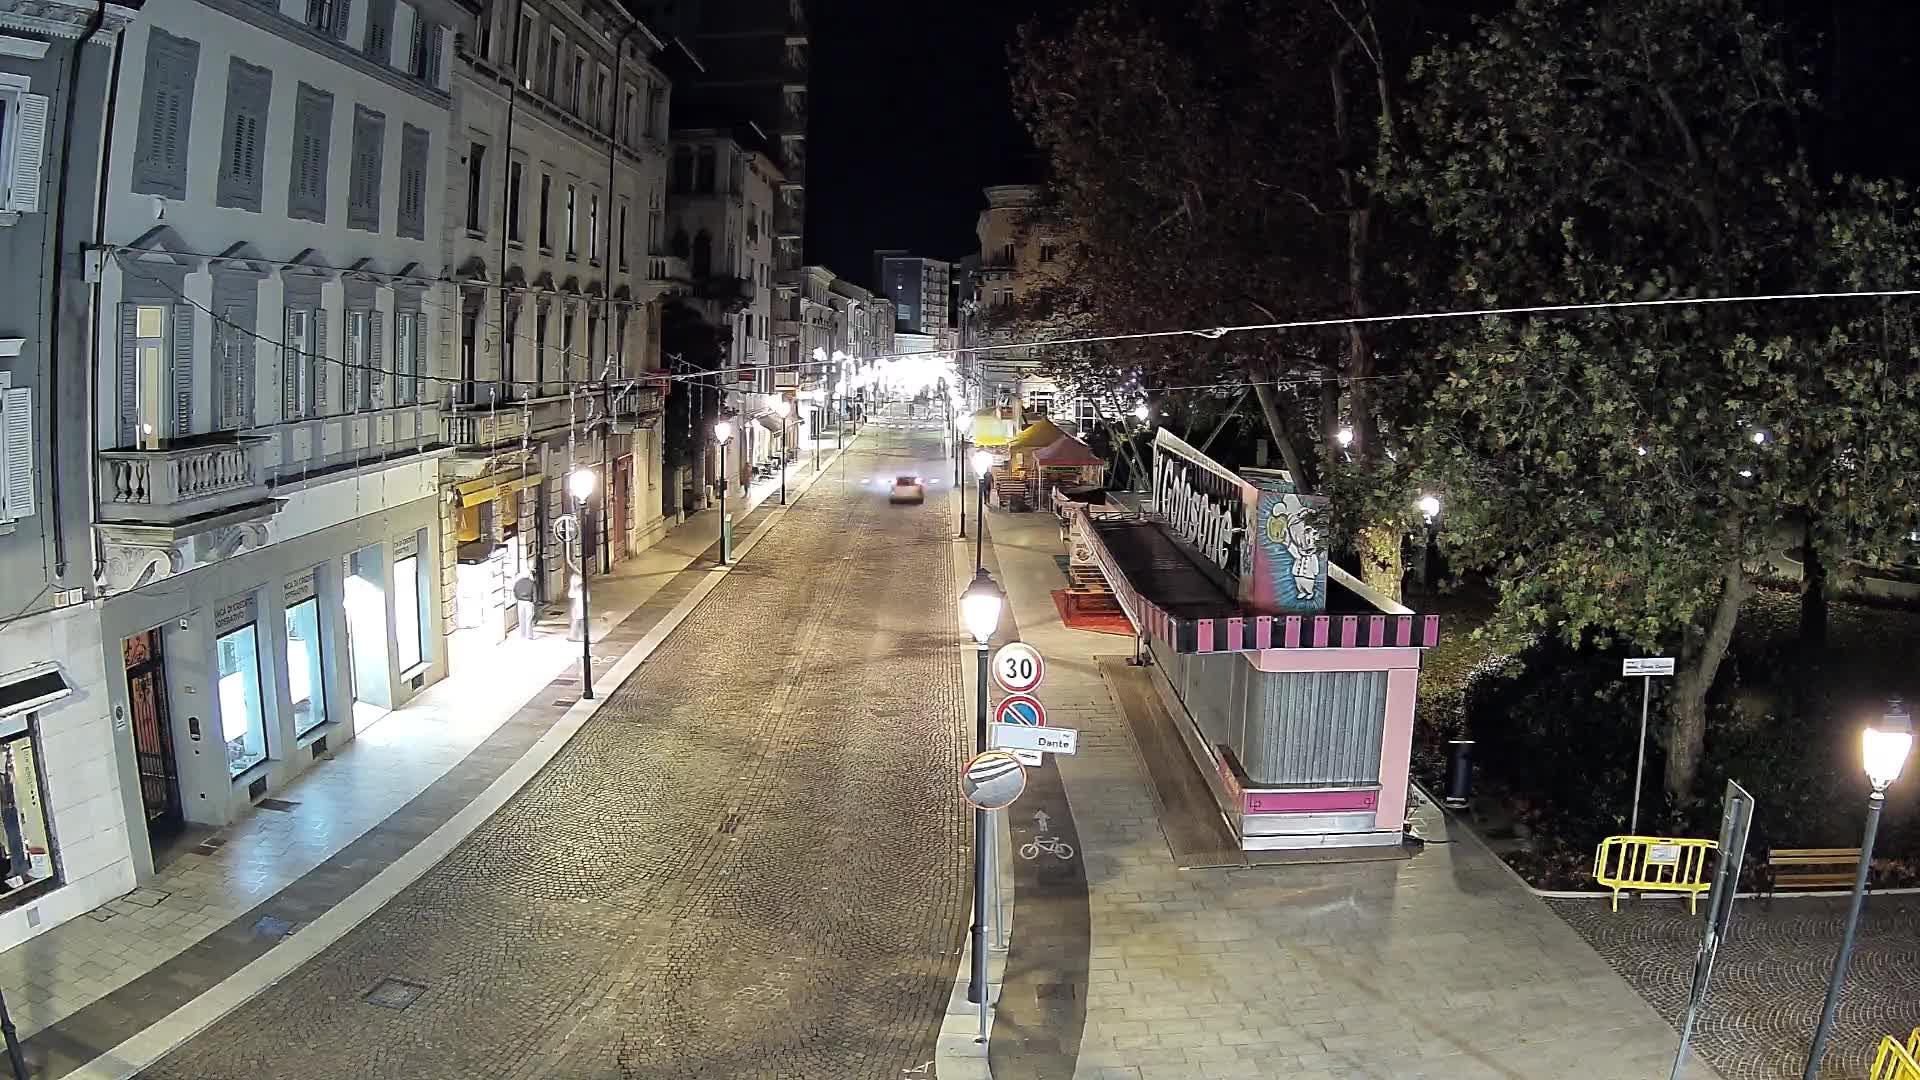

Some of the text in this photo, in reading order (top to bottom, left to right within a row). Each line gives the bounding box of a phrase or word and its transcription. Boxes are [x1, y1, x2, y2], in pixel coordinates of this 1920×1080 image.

[1162, 459, 1232, 569] Golosone
[1006, 657, 1032, 679] 30
[1038, 737, 1069, 748] Dante
